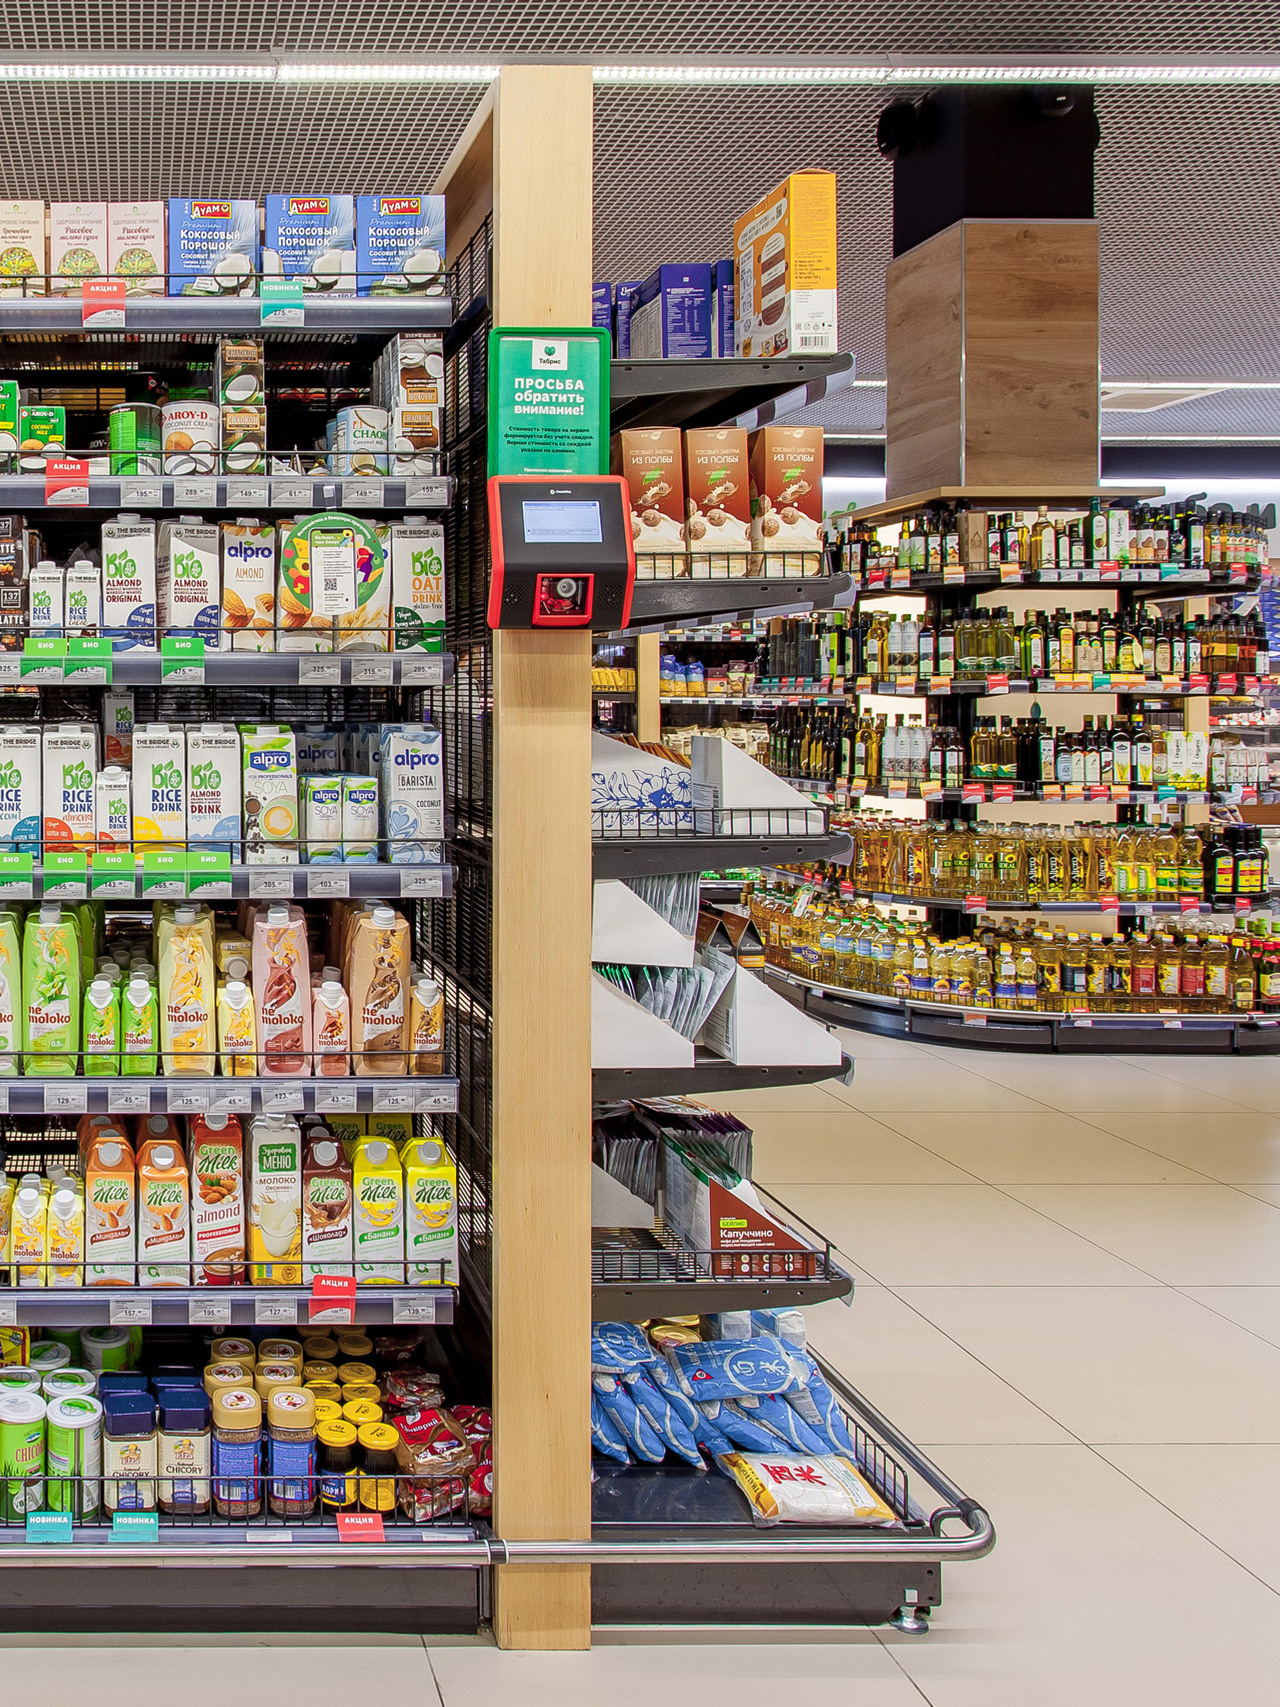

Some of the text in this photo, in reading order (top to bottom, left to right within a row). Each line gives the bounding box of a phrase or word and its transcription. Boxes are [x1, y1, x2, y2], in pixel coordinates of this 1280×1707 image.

[191, 204, 220, 219] AYAM
[181, 229, 241, 240] КОКОСОВЫЙ
[278, 226, 338, 236] КОКОСОВЫЙ
[369, 226, 430, 236] КОКОСОВЫЙ
[181, 240, 232, 250] ПОРОШОК
[278, 237, 331, 247] ПОРОШОК
[369, 237, 422, 247] ПОРОШОК
[515, 378, 584, 390] ПРОСЬБА
[515, 390, 584, 404] обратить
[515, 405, 584, 415] внимание!
[786, 454, 814, 462] ПОЛБЫ
[228, 541, 272, 562] alpro
[235, 567, 264, 579] ALMOND
[106, 579, 141, 587] ALMOND
[412, 577, 442, 590] OAT
[174, 595, 208, 603] ORIGINAL
[412, 594, 442, 602] DRINK
[0, 615, 24, 625] LATTE
[253, 755, 287, 769] alpro
[401, 775, 434, 787] BARISTA
[254, 781, 287, 794] SOYA
[315, 806, 338, 815] SOYA
[200, 1144, 235, 1155] Green
[260, 1146, 292, 1155] Здоровое
[198, 1155, 239, 1174] Milk
[262, 1154, 291, 1170] МЕНЮ
[94, 1179, 126, 1188] Green
[148, 1181, 180, 1190] Green
[310, 1179, 343, 1187] Green
[93, 1186, 129, 1203] Milk
[147, 1189, 182, 1206] Milk
[196, 1204, 240, 1224] almond
[198, 1226, 239, 1239] PROFESSIONAL
[363, 1230, 395, 1241] «Банан»
[418, 1231, 450, 1242] «Банан»
[720, 1229, 773, 1239] Капуччино
[166, 1465, 203, 1474] CHICORY
